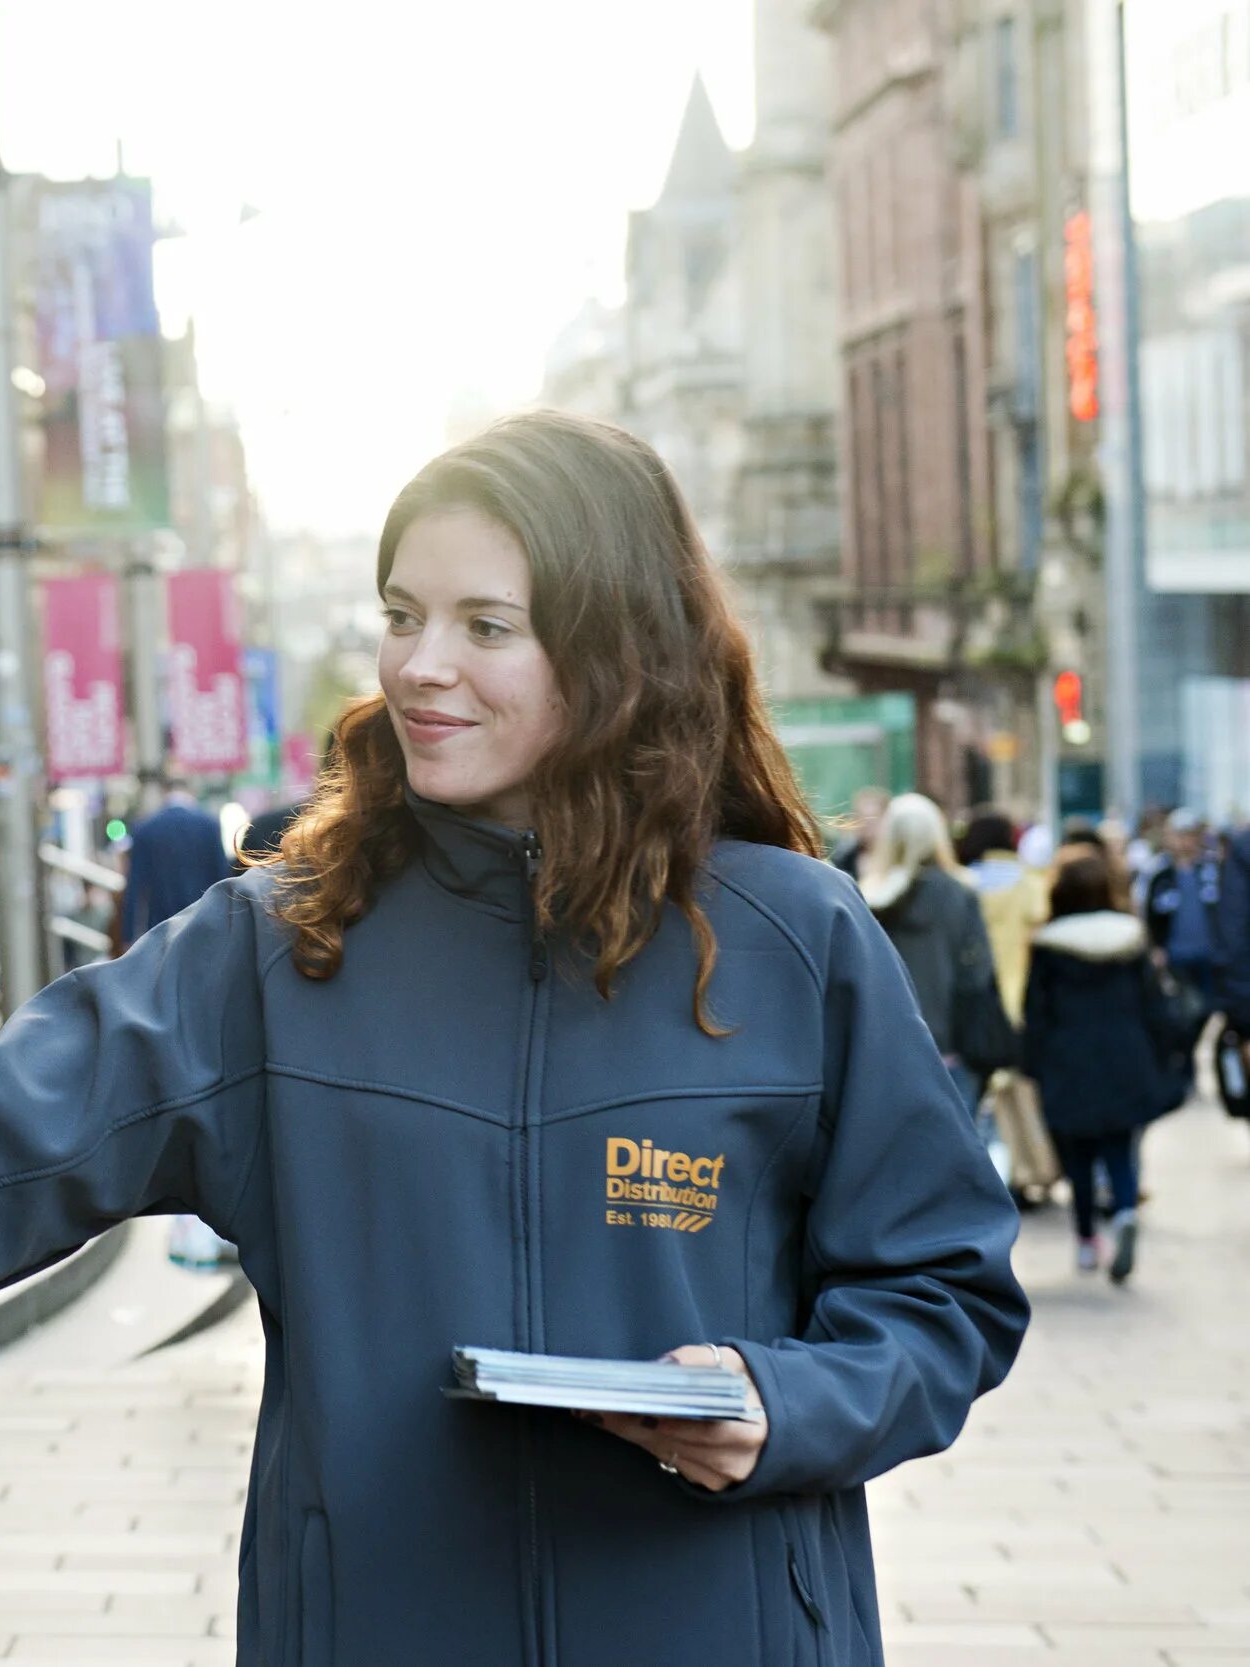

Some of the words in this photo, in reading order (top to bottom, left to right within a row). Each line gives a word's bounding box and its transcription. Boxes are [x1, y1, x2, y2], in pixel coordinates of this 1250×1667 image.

[606, 1137, 726, 1189] Direct
[606, 1178, 718, 1209] Distribution
[606, 1210, 635, 1226] Est.
